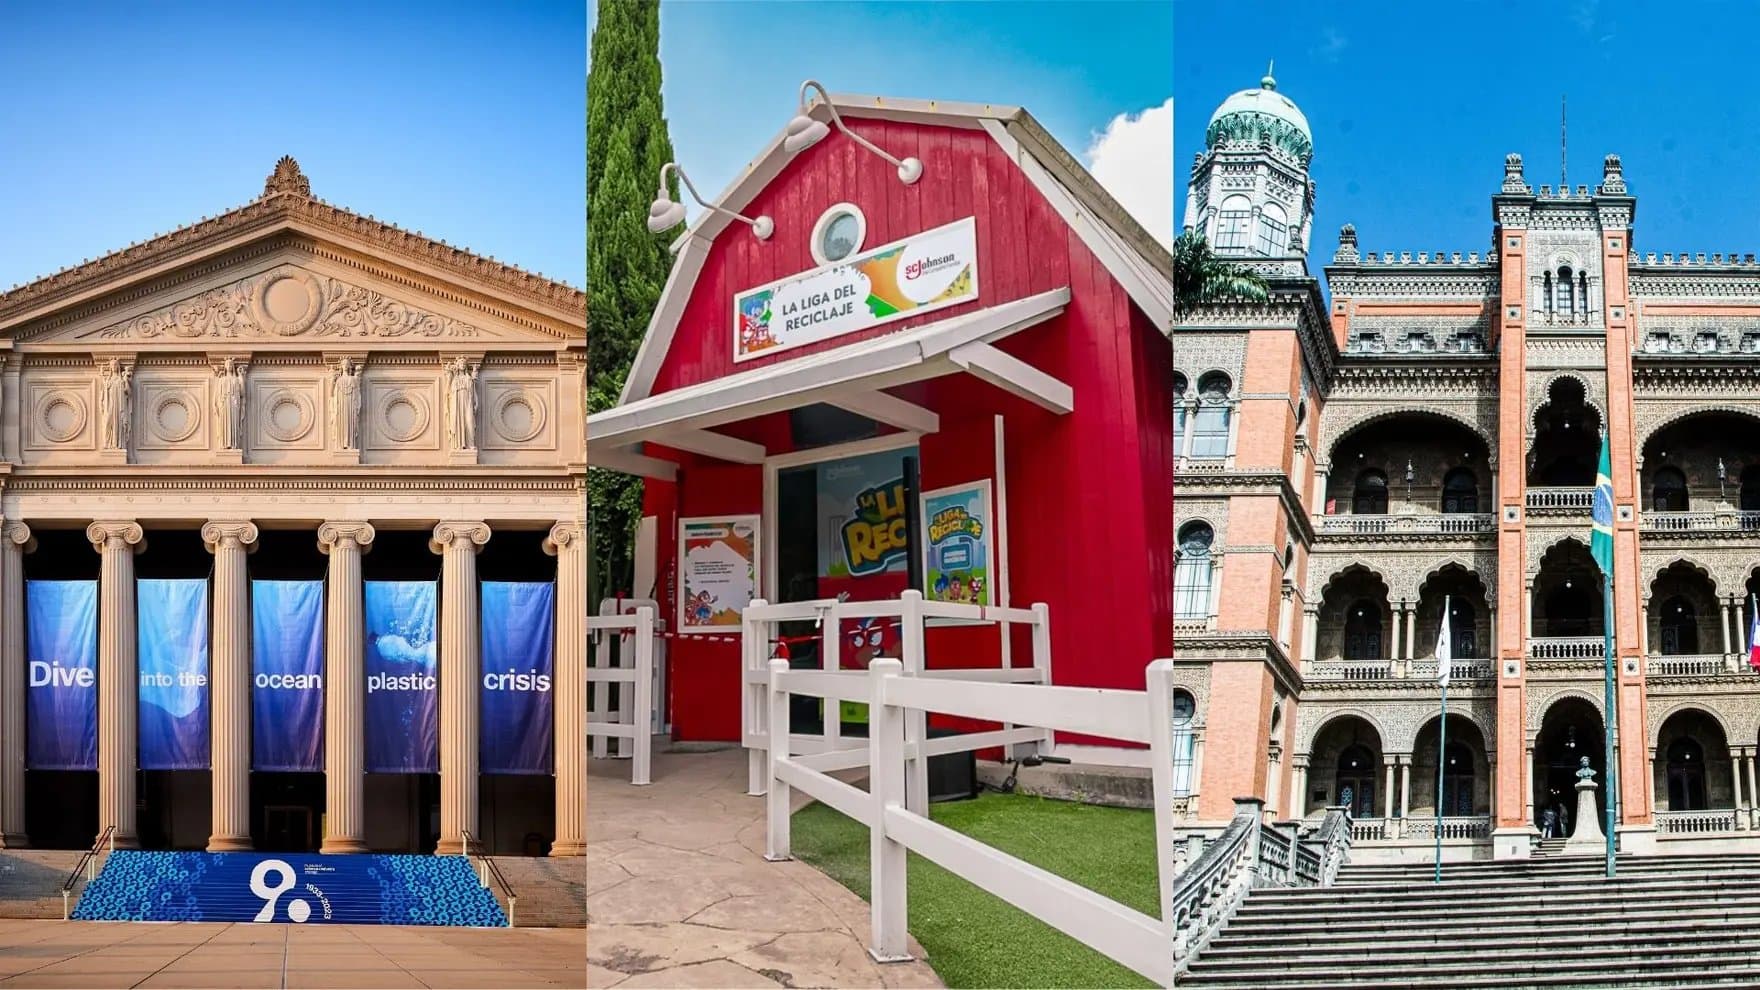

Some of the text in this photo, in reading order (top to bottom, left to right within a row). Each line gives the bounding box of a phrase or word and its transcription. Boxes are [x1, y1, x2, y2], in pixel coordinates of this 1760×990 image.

[782, 283, 857, 316] LA LIGA DEL
[785, 301, 854, 332] RECICLAJE
[29, 660, 95, 688] Dive
[140, 670, 208, 688] into the
[255, 673, 322, 689] ocean
[367, 671, 436, 692] plastic
[483, 668, 551, 692] crisis
[304, 882, 333, 920] 1933-2023
